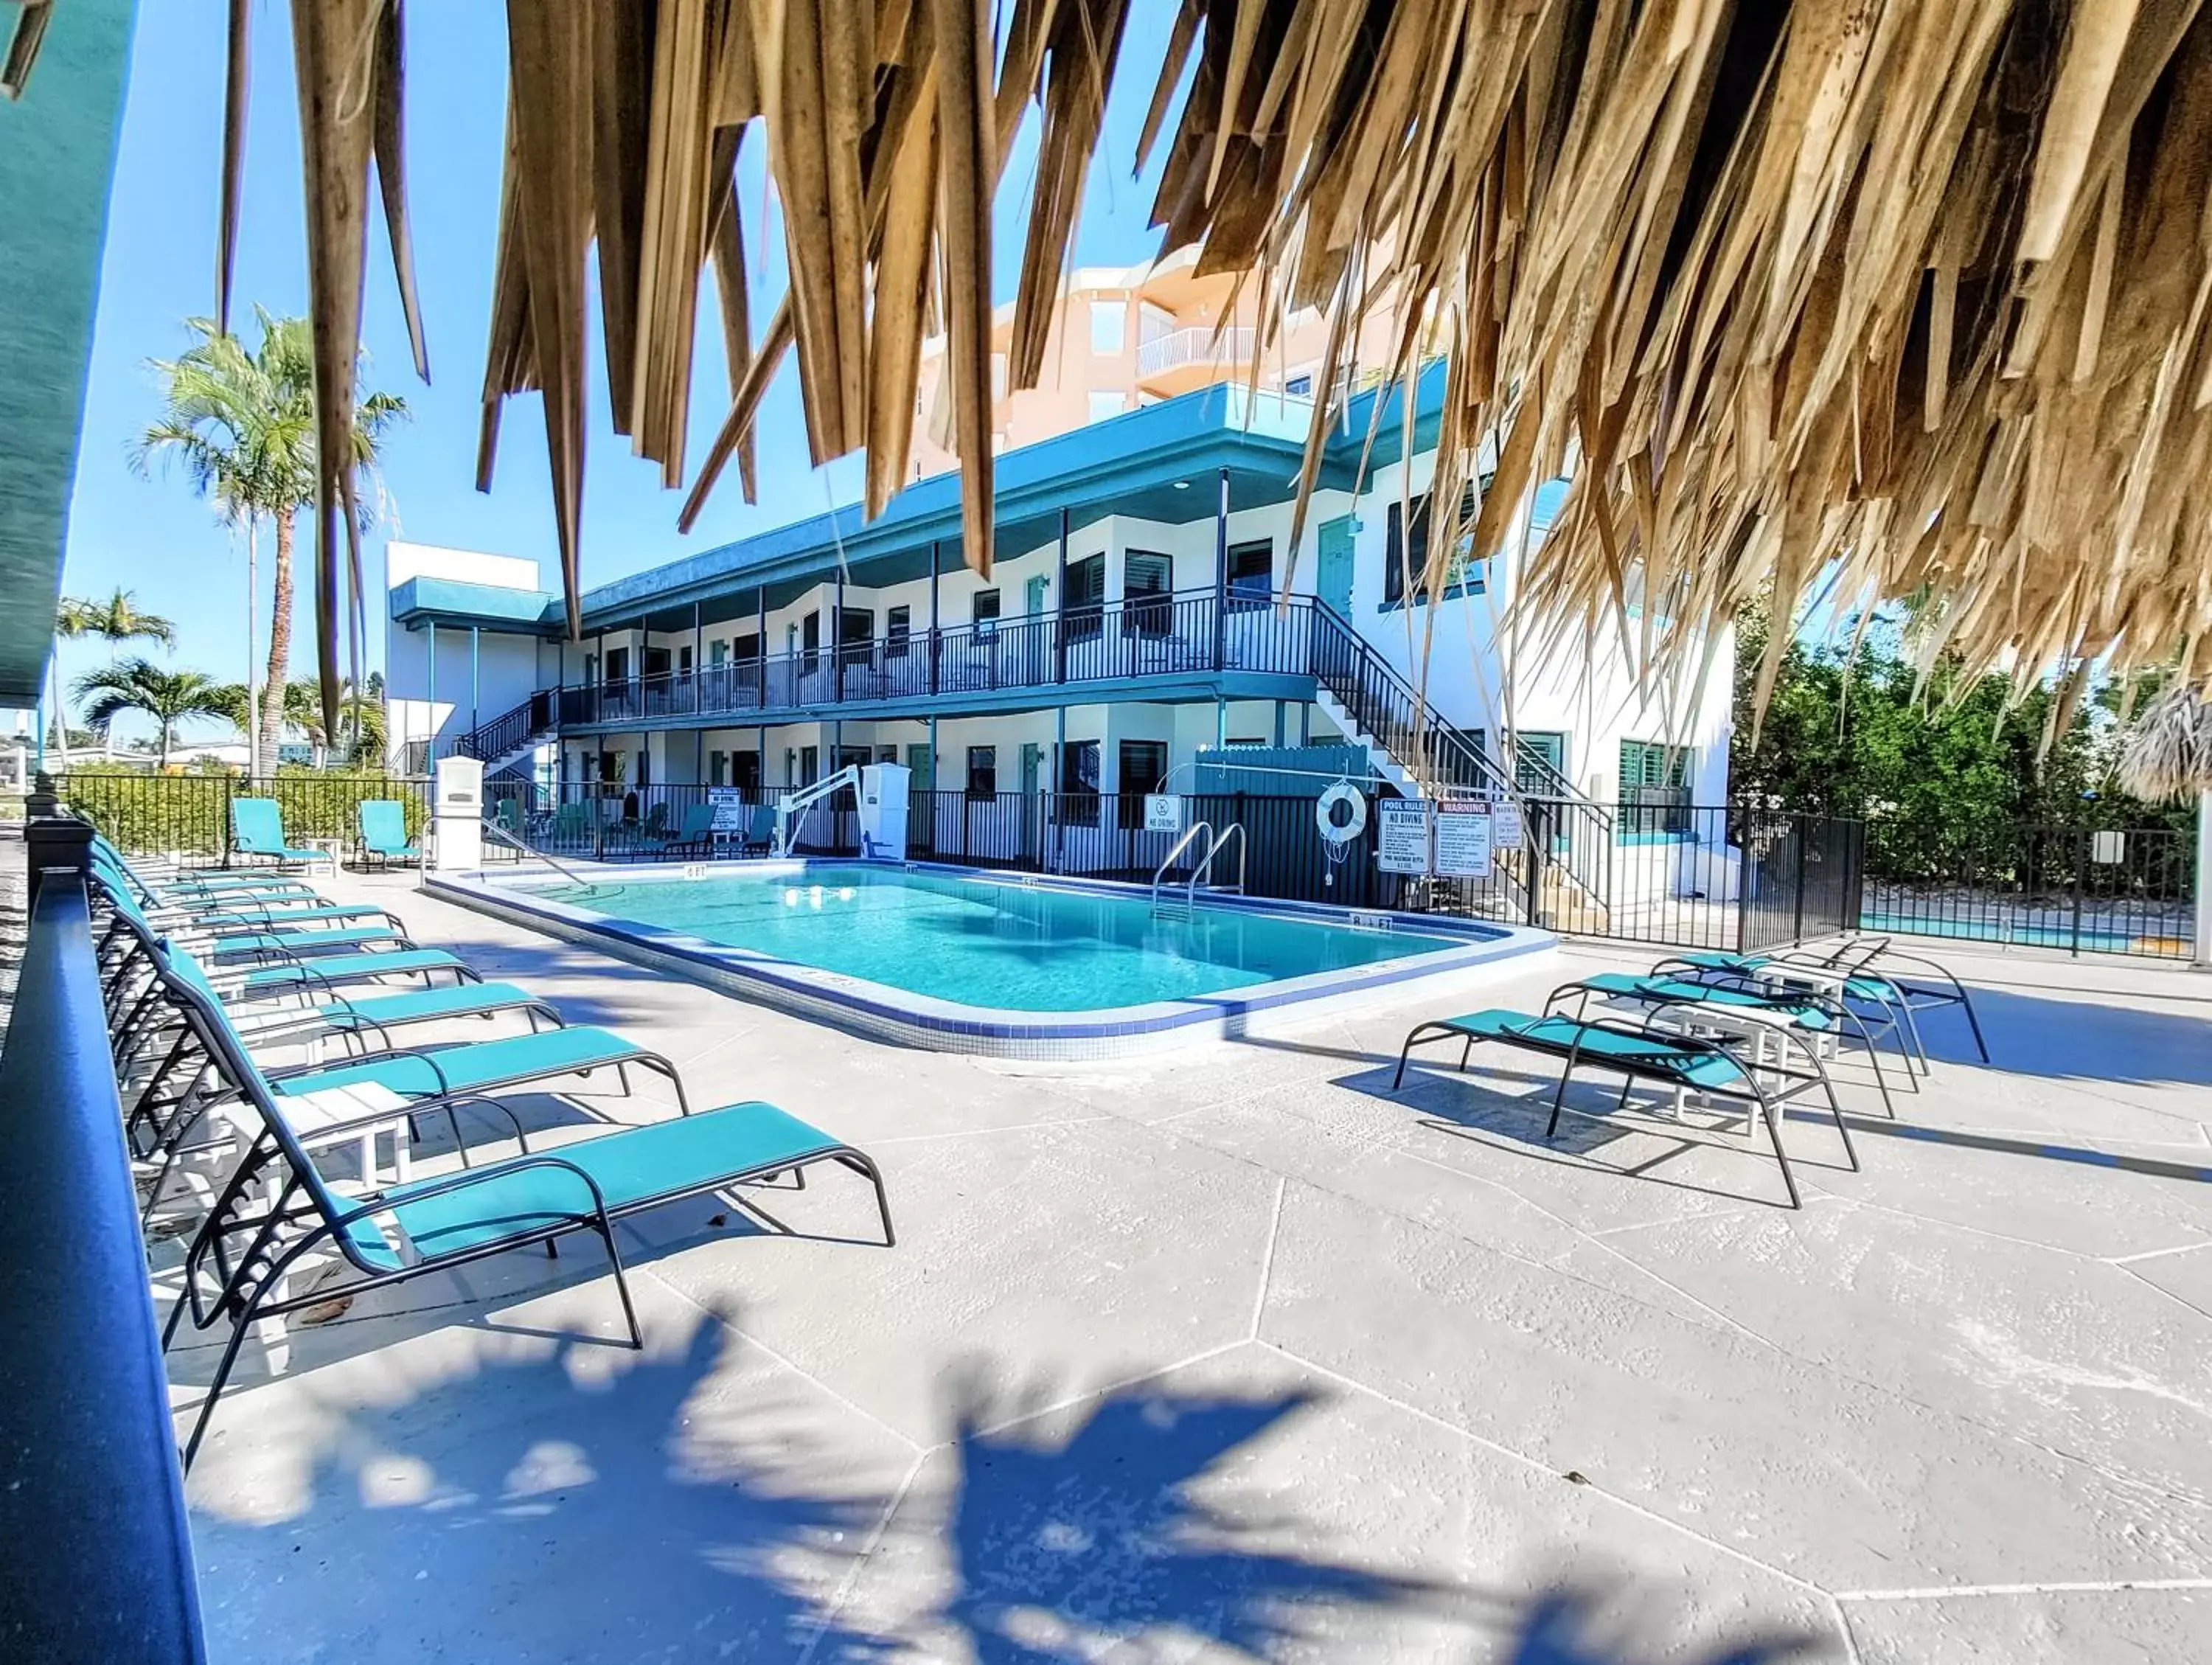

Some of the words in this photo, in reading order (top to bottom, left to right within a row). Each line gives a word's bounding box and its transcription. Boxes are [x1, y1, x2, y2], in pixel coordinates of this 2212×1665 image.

[1385, 802, 1403, 810] POOL
[1404, 802, 1425, 810] RULE
[1443, 803, 1486, 813] WARNING
[1389, 813, 1399, 823] NO
[1401, 813, 1422, 824] DIVING
[696, 867, 705, 877] FT
[1379, 918, 1391, 930] FT
